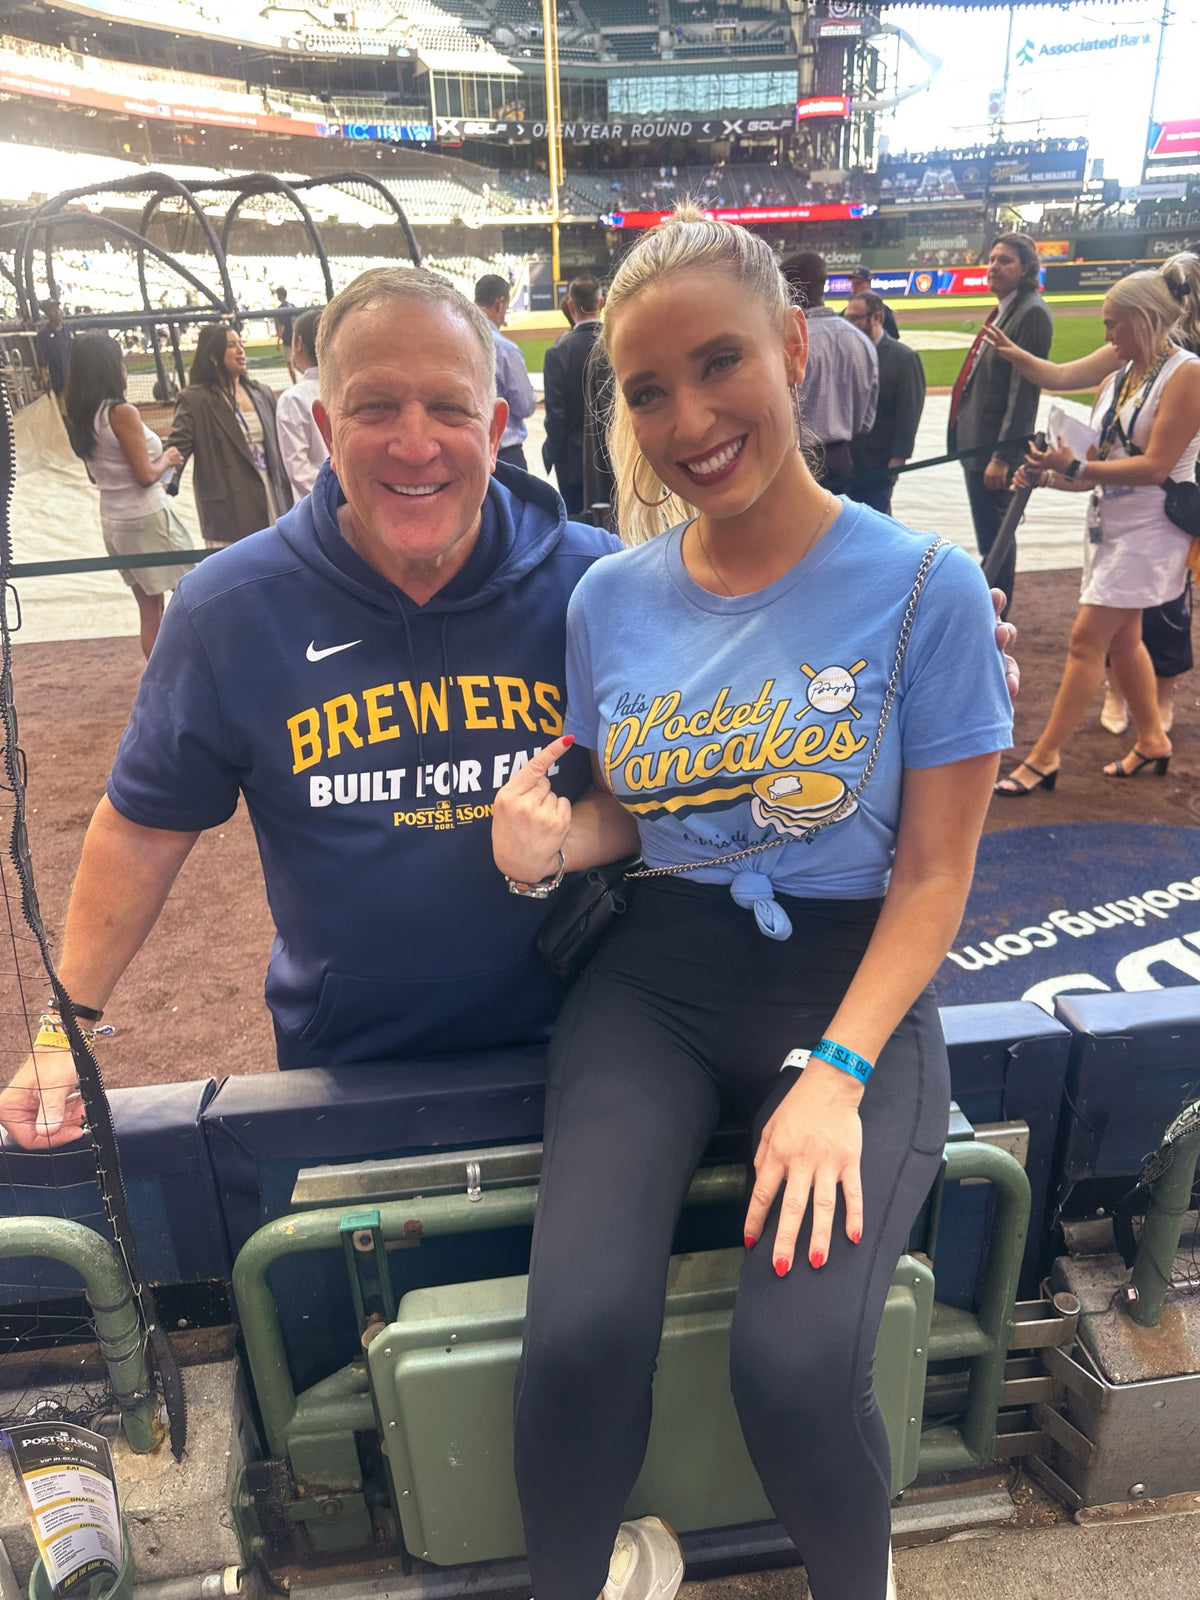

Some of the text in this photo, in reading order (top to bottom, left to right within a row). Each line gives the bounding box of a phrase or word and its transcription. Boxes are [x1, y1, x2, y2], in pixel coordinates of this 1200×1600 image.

[1038, 32, 1152, 56] Associated Bank
[463, 122, 508, 135] GOLF
[581, 124, 622, 139] YEAR
[631, 122, 692, 138] ROUND
[747, 119, 793, 132] GOLF
[825, 250, 862, 264] clover
[611, 691, 649, 718] Pat's
[635, 678, 776, 747] Pocket
[286, 675, 564, 775] BREWERS
[603, 698, 869, 793] Pancakes
[309, 746, 560, 807] BUILT FOR FA
[393, 803, 495, 827] POSTSEASON
[946, 875, 1200, 971] ooking.com
[22, 1435, 98, 1452] POSTSEASON
